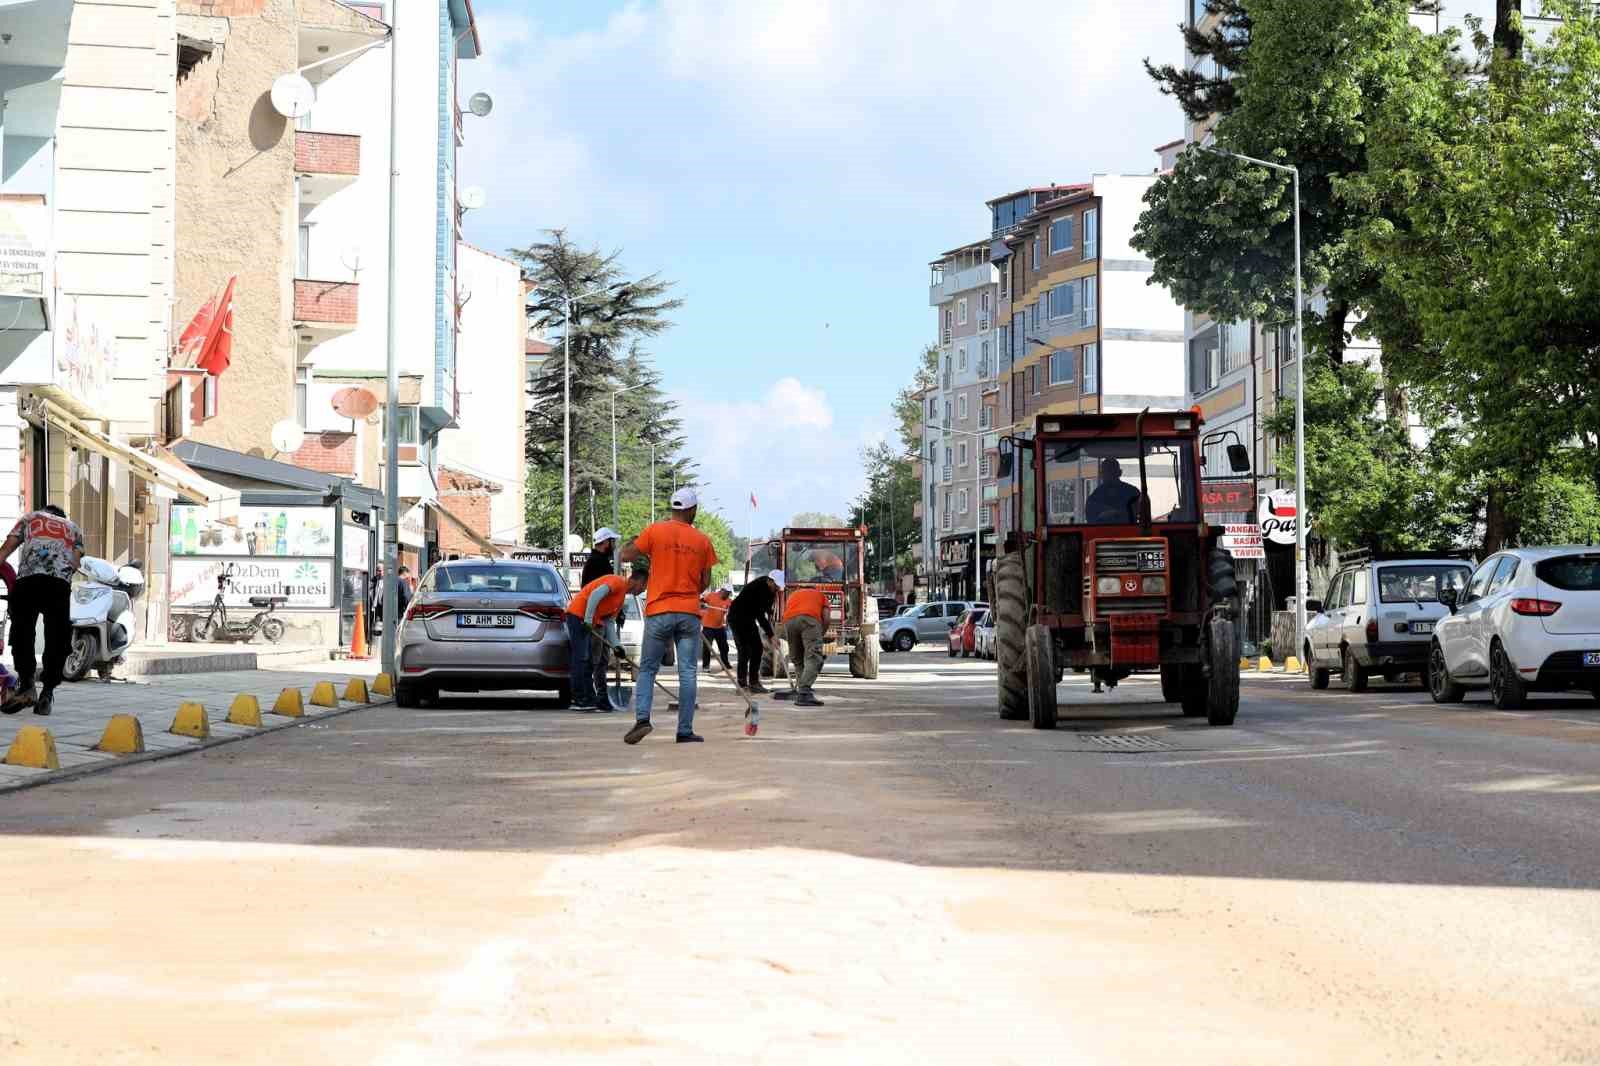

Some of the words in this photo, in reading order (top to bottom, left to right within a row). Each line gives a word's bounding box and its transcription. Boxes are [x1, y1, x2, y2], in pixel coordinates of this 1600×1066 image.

[1233, 537, 1262, 545] KASAP
[1234, 549, 1263, 557] TAVUK
[463, 615, 472, 624] 16
[475, 615, 492, 624] AHM
[1588, 654, 1600, 663] 26
